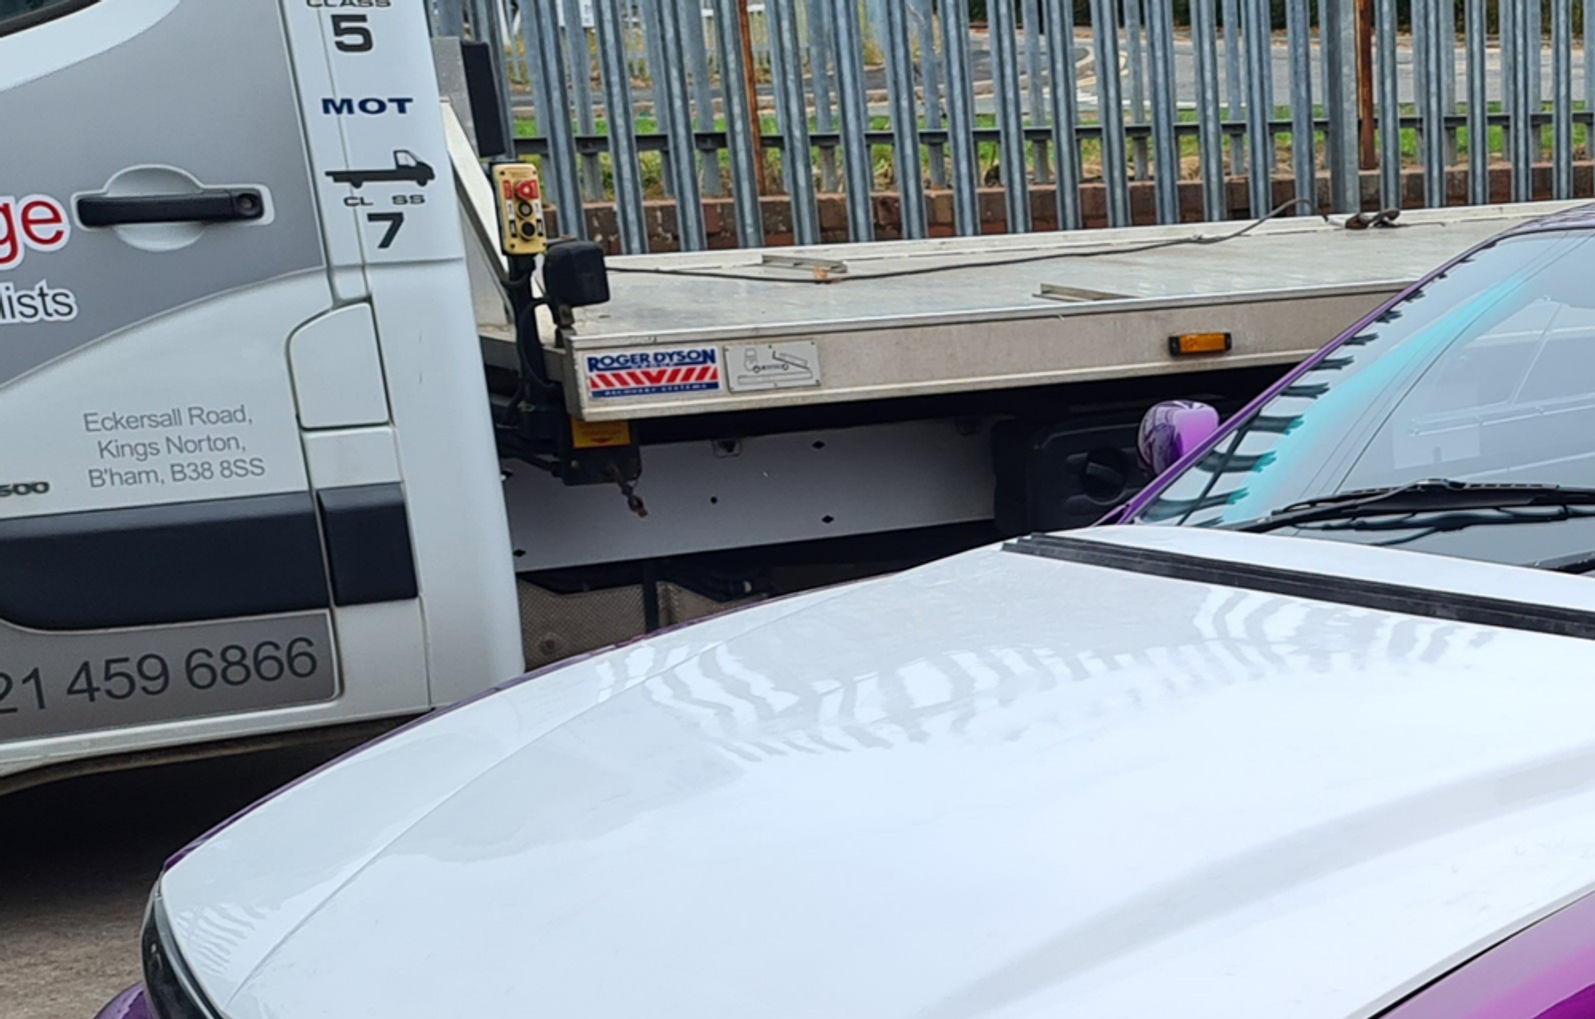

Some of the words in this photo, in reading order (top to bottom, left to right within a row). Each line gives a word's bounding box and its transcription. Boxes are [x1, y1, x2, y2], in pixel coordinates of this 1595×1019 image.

[330, 14, 374, 53] 5
[321, 98, 413, 114] MOT
[366, 212, 404, 249] 7
[587, 353, 650, 373] ROGER
[653, 348, 716, 366] DYSON
[83, 408, 182, 432] Eckersall
[188, 404, 252, 426] Road,
[97, 439, 160, 462] Kings
[166, 433, 246, 454] Norton,
[88, 468, 165, 488] B'ham,
[170, 462, 214, 482] B38
[219, 458, 266, 479] 8SS
[66, 653, 170, 702] 459
[185, 636, 318, 690] 6866
